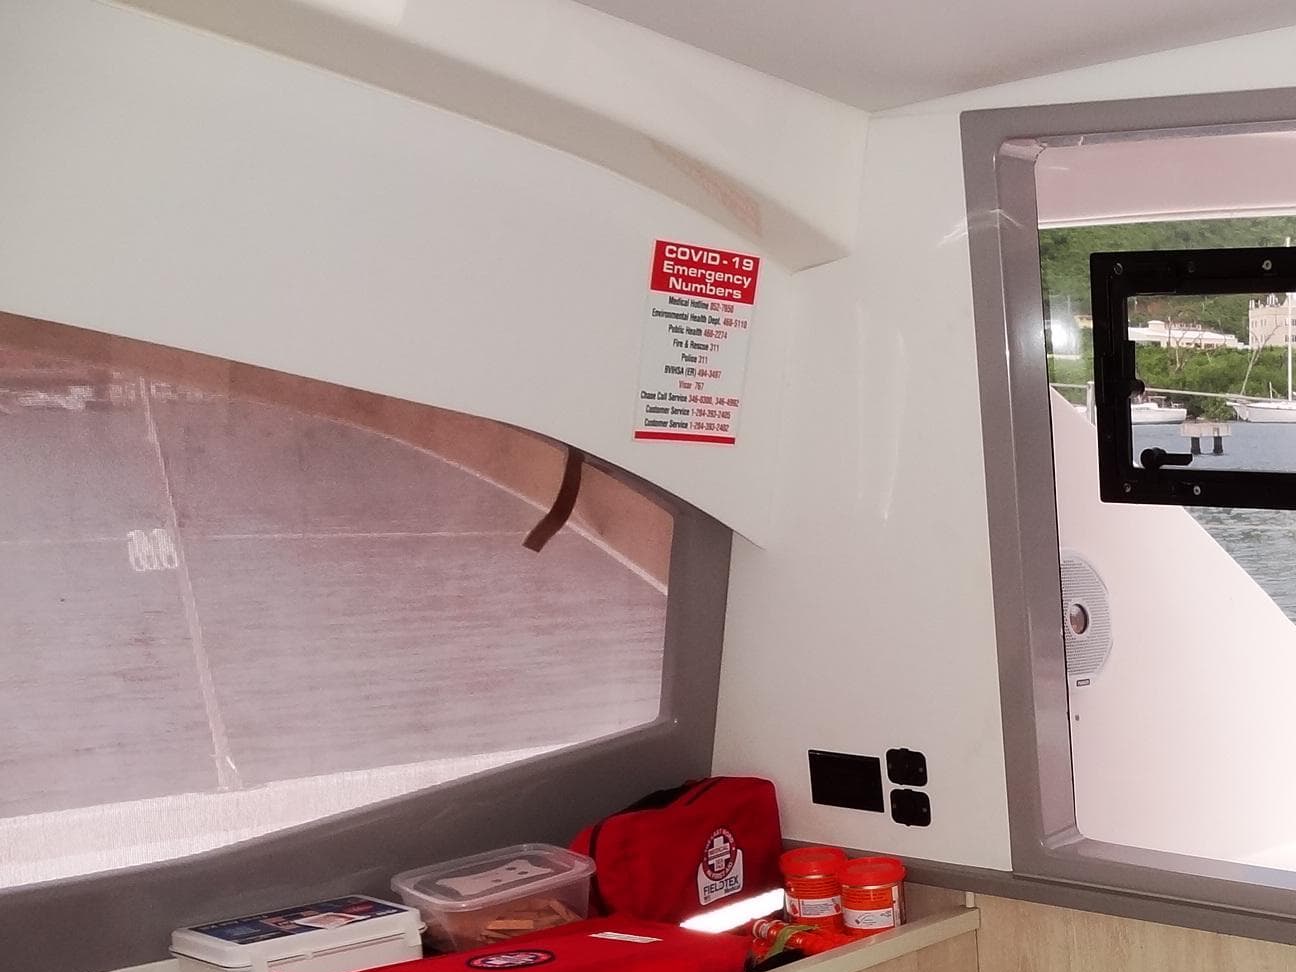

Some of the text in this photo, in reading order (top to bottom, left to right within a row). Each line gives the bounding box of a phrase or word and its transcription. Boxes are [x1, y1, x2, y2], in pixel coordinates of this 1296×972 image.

[663, 261, 751, 288] Emergency
[669, 277, 742, 299] Numbers
[668, 296, 689, 307] Medical
[691, 299, 709, 310] Hotline
[652, 308, 689, 320] Environmental
[690, 313, 706, 323] Health
[708, 315, 721, 326] Dept.
[668, 324, 684, 334] Public
[686, 326, 702, 336] Health
[673, 338, 719, 352] Fire & Rescue 311
[681, 353, 697, 363] Police
[668, 392, 687, 402] Service
[645, 404, 669, 414] Customer
[671, 406, 690, 416] Service
[644, 418, 668, 428] Customer
[669, 419, 688, 429] Service
[703, 875, 739, 896] FIELDTEX
